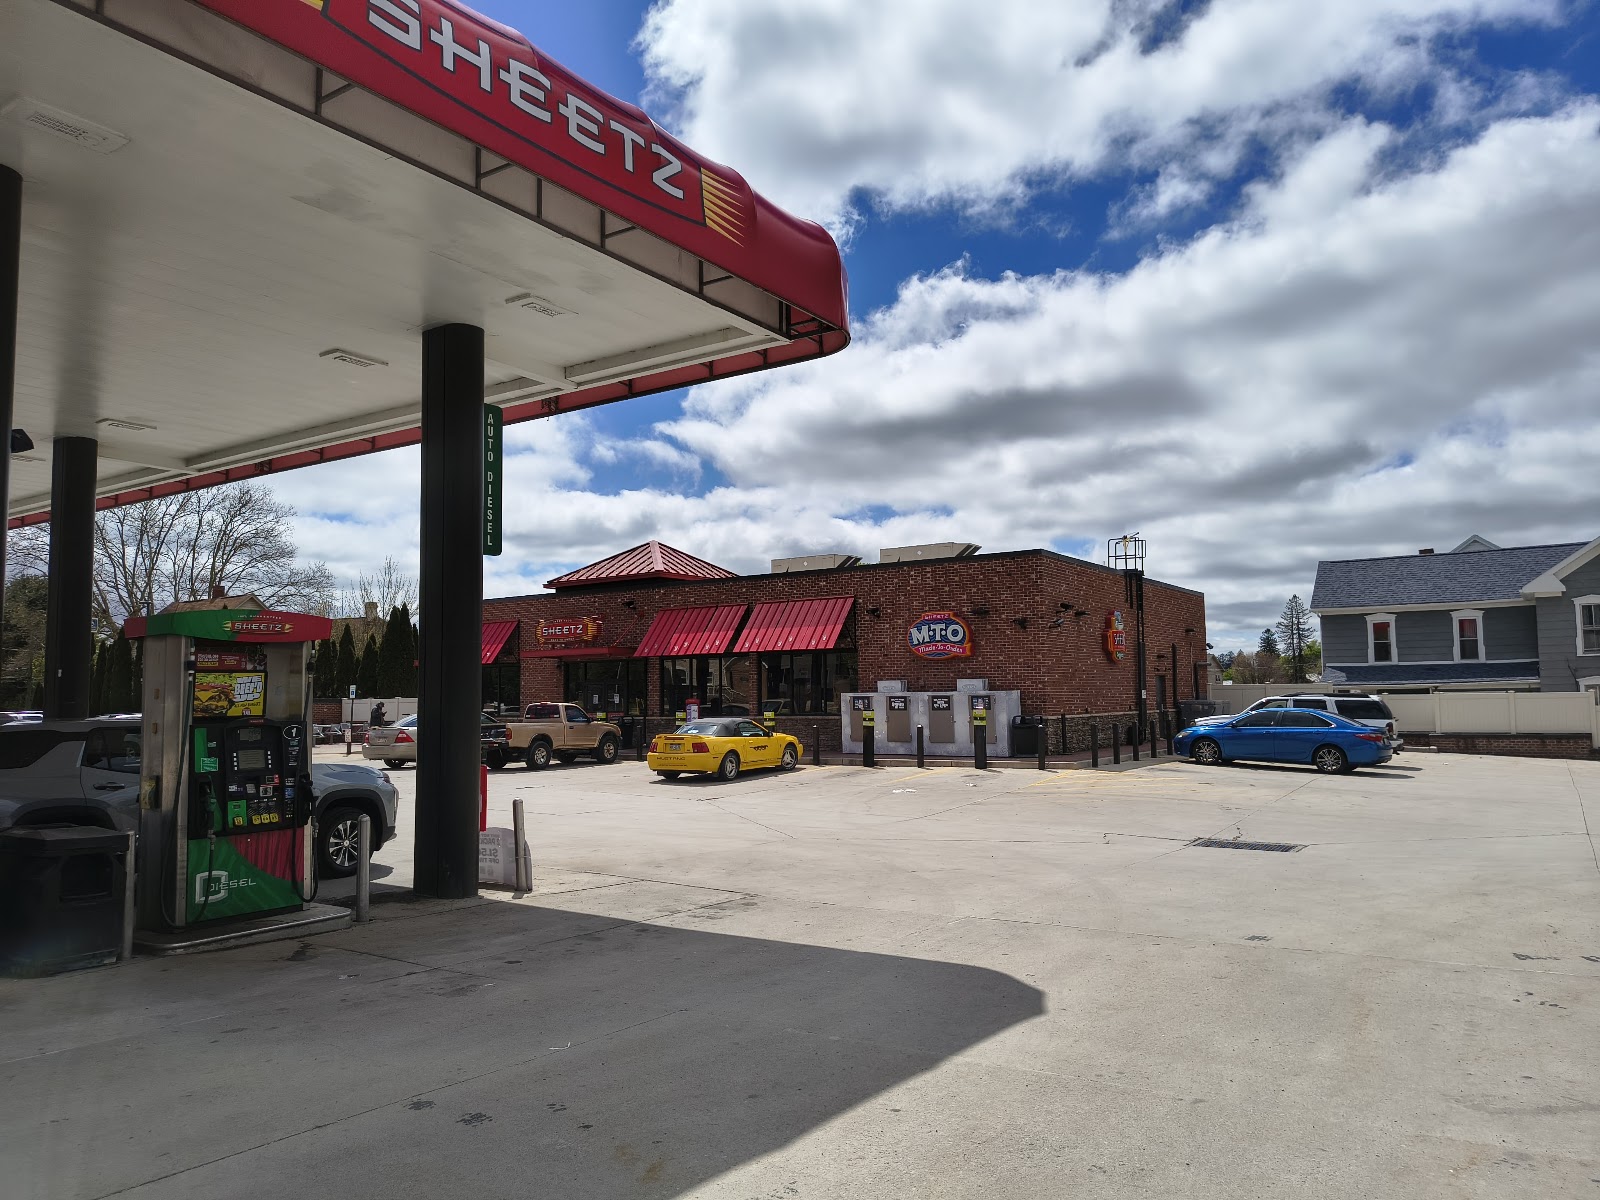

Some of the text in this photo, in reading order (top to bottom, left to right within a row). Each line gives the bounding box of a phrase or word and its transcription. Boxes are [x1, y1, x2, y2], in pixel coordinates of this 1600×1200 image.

[368, 0, 685, 201] SHEETZ
[486, 471, 494, 546] DIESEL
[234, 622, 283, 631] SHEETZ
[542, 624, 583, 636] SHEETZ
[291, 727, 297, 737] 1
